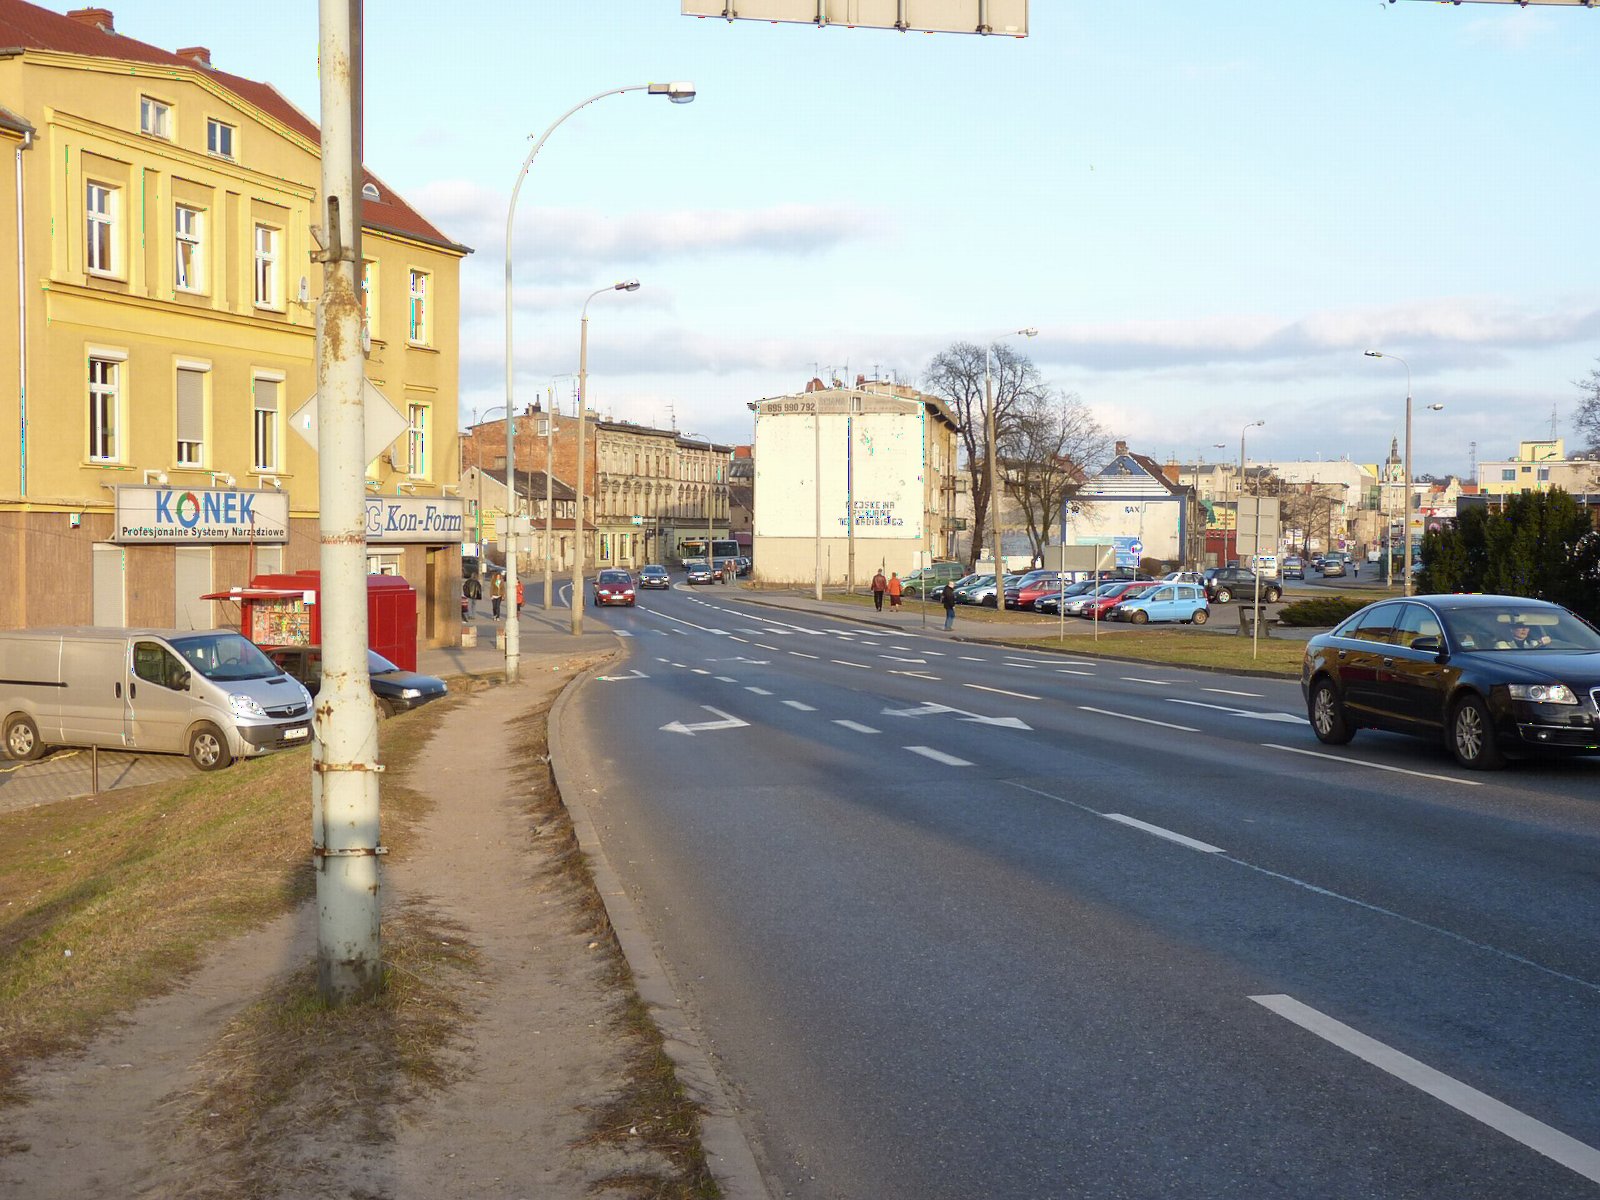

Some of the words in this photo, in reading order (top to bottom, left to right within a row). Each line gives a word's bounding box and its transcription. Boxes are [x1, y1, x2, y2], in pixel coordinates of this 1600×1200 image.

[768, 403, 782, 412] 695
[784, 403, 799, 412] 990
[800, 402, 815, 411] 792
[156, 490, 255, 528] KONEK
[385, 505, 461, 531] Kon-Form
[122, 526, 189, 538] Profesjonalne
[192, 527, 229, 539] Systemy
[232, 527, 284, 538] Narzędziowe
